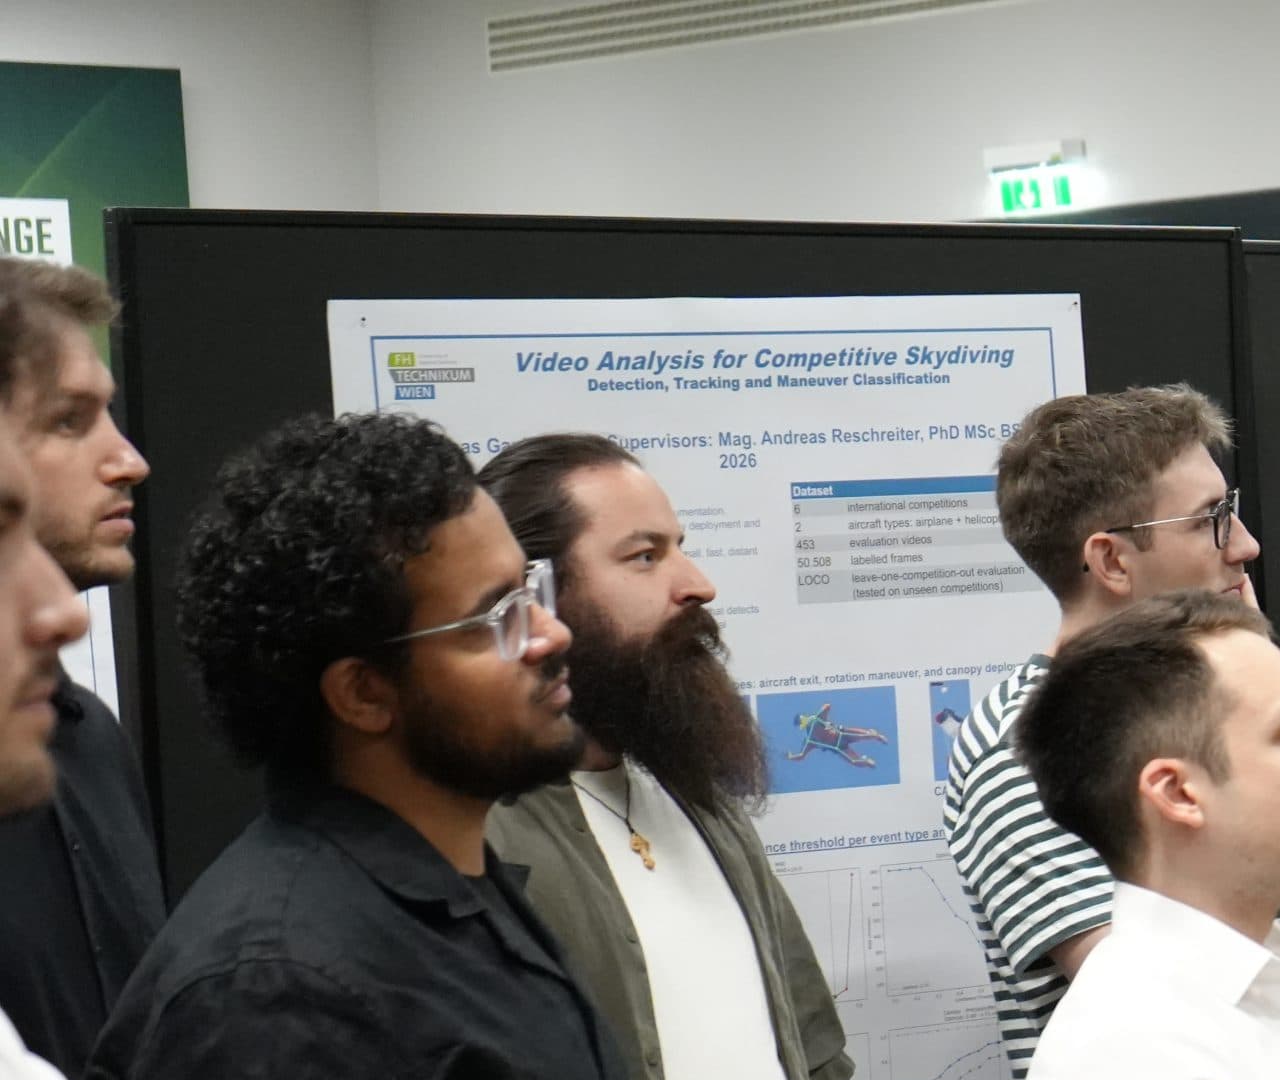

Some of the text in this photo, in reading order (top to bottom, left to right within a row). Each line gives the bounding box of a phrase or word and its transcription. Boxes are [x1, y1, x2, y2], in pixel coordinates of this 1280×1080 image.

[0, 217, 54, 254] NGE
[394, 354, 414, 366] FH
[516, 345, 1014, 375] Video Analysis for Competitive Skydiving
[396, 369, 472, 383] TECHNIKUM
[587, 371, 950, 393] Detection, Tracking and Maneuver Classification
[398, 386, 433, 399] WIEN
[608, 433, 712, 451] Supervisors:
[718, 431, 757, 449] Mag.
[761, 429, 826, 446] Andreas
[832, 427, 924, 443] Reschreiter,
[928, 425, 959, 440] PhD
[964, 424, 996, 439] MSc
[719, 453, 757, 469] 2026
[792, 485, 833, 497] Dataset
[794, 503, 801, 515] 6
[847, 498, 968, 513] international competitions
[688, 518, 760, 532] deployment and
[795, 521, 802, 533] 2
[848, 518, 882, 530] aircraft
[884, 517, 912, 531] types:
[915, 516, 953, 528] airplane
[964, 513, 1001, 528] helicop
[796, 539, 815, 551] 453
[849, 534, 932, 548] evaluation videos
[851, 553, 923, 566] labelled frames
[798, 574, 830, 586] LOCO
[852, 564, 1025, 584] leave-one-competition-out evaluation
[853, 580, 1003, 600] (tested on unseen competitions)
[759, 675, 797, 689] aircraft
[800, 673, 822, 687] exit,
[825, 671, 865, 684] rotation
[868, 667, 920, 682] maneuver,
[924, 665, 943, 678] and
[945, 663, 982, 679] canopy
[790, 836, 845, 852] threshold
[849, 834, 868, 849] per
[870, 831, 902, 845] event
[905, 829, 929, 844] type
